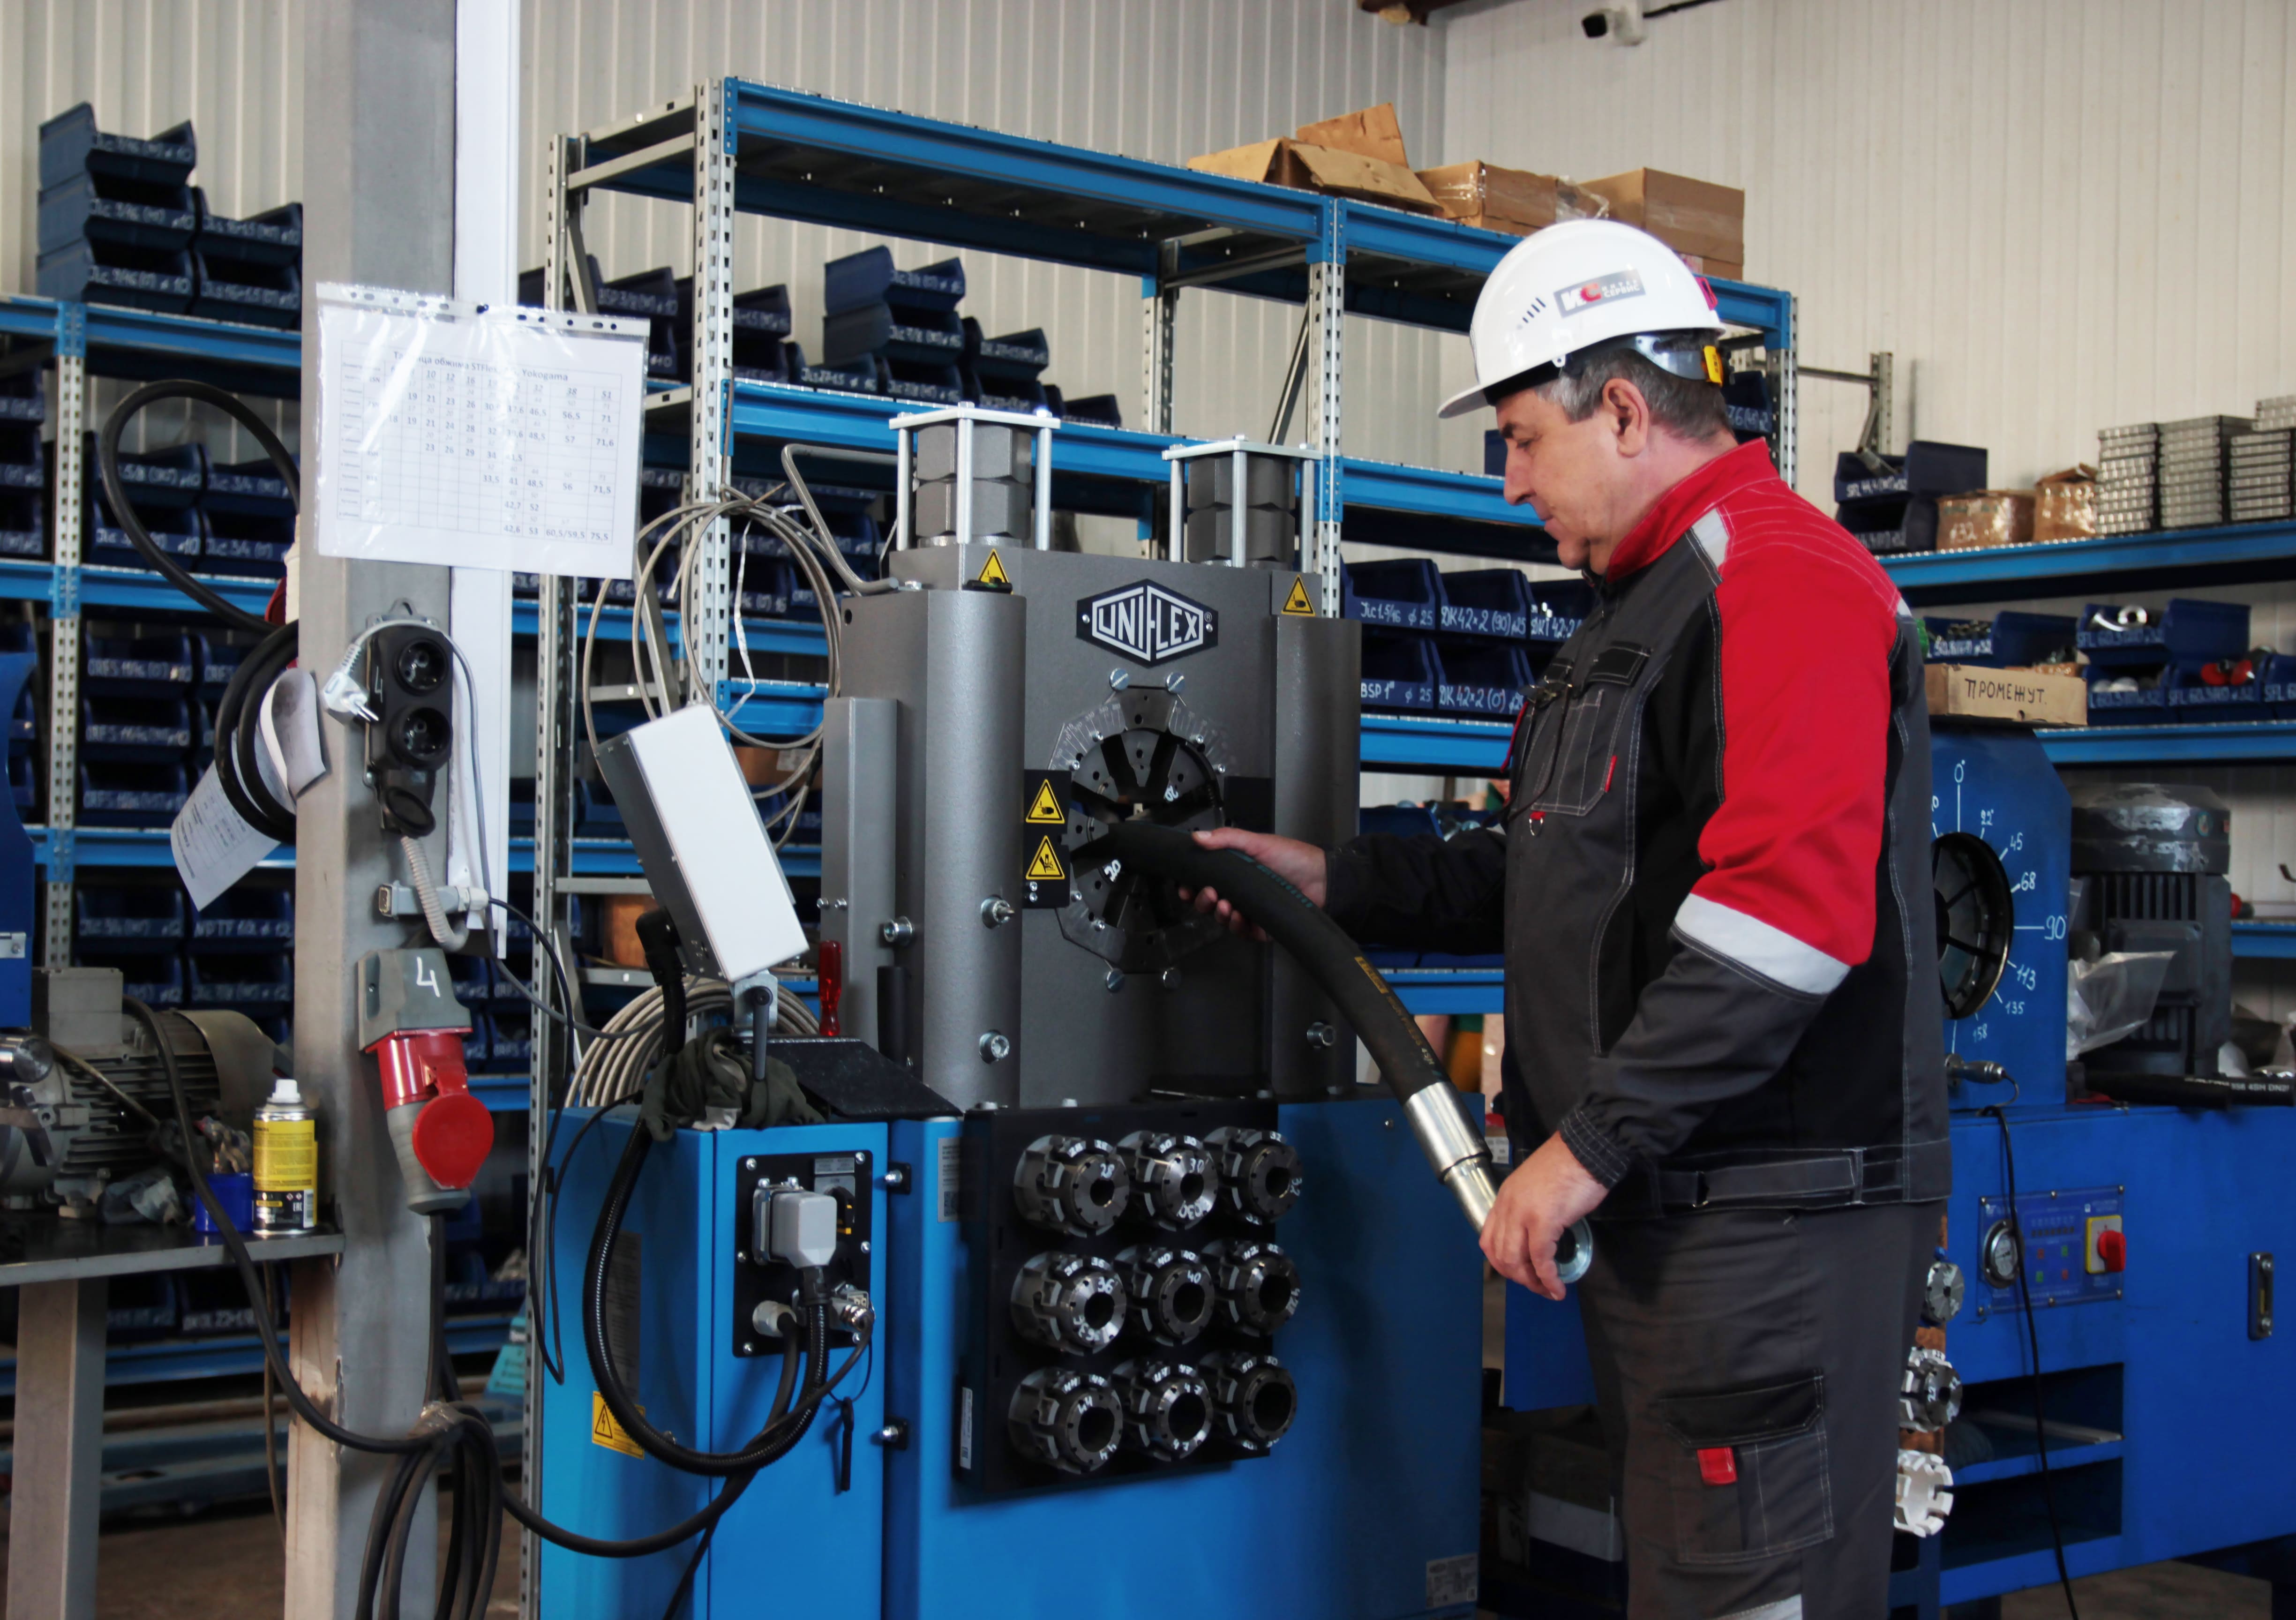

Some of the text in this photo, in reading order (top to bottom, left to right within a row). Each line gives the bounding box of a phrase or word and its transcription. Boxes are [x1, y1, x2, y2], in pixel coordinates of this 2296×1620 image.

[1604, 285, 1640, 298] СЕРВИС
[394, 351, 432, 364] Таца
[435, 359, 469, 370] обжима
[522, 368, 568, 381] Yokogama
[427, 370, 436, 379] 10
[602, 390, 611, 399] 51
[563, 411, 580, 420] 56,5
[596, 438, 614, 447] 71,6
[482, 475, 499, 484] 33,5
[527, 480, 543, 488] 48,5
[593, 485, 611, 494] 71,5
[591, 532, 609, 541] 75,5
[1096, 585, 1200, 661] UNIFLEX
[1420, 610, 1433, 625] 25
[1360, 682, 1381, 698] BSP
[1420, 689, 1432, 702] 25
[1965, 678, 2047, 705] ПРОМЕЖУТ.
[2010, 832, 2023, 851] 45
[2021, 871, 2036, 891] 68
[417, 957, 441, 997] 4
[2017, 964, 2036, 991] 113
[2005, 1001, 2025, 1015] 135
[1973, 1023, 1988, 1043] 158
[1270, 1131, 1282, 1142] 32
[1189, 1158, 1204, 1173] 30
[1290, 1178, 1302, 1196] 32
[1158, 1253, 1171, 1265] 40
[1187, 1270, 1201, 1283] 40
[1098, 1277, 1114, 1294] 36
[1242, 1360, 1253, 1372] 50
[1266, 1356, 1277, 1365] 50
[1064, 1378, 1077, 1391] 44
[1092, 1375, 1104, 1385] 44
[1077, 1396, 1093, 1414] 44
